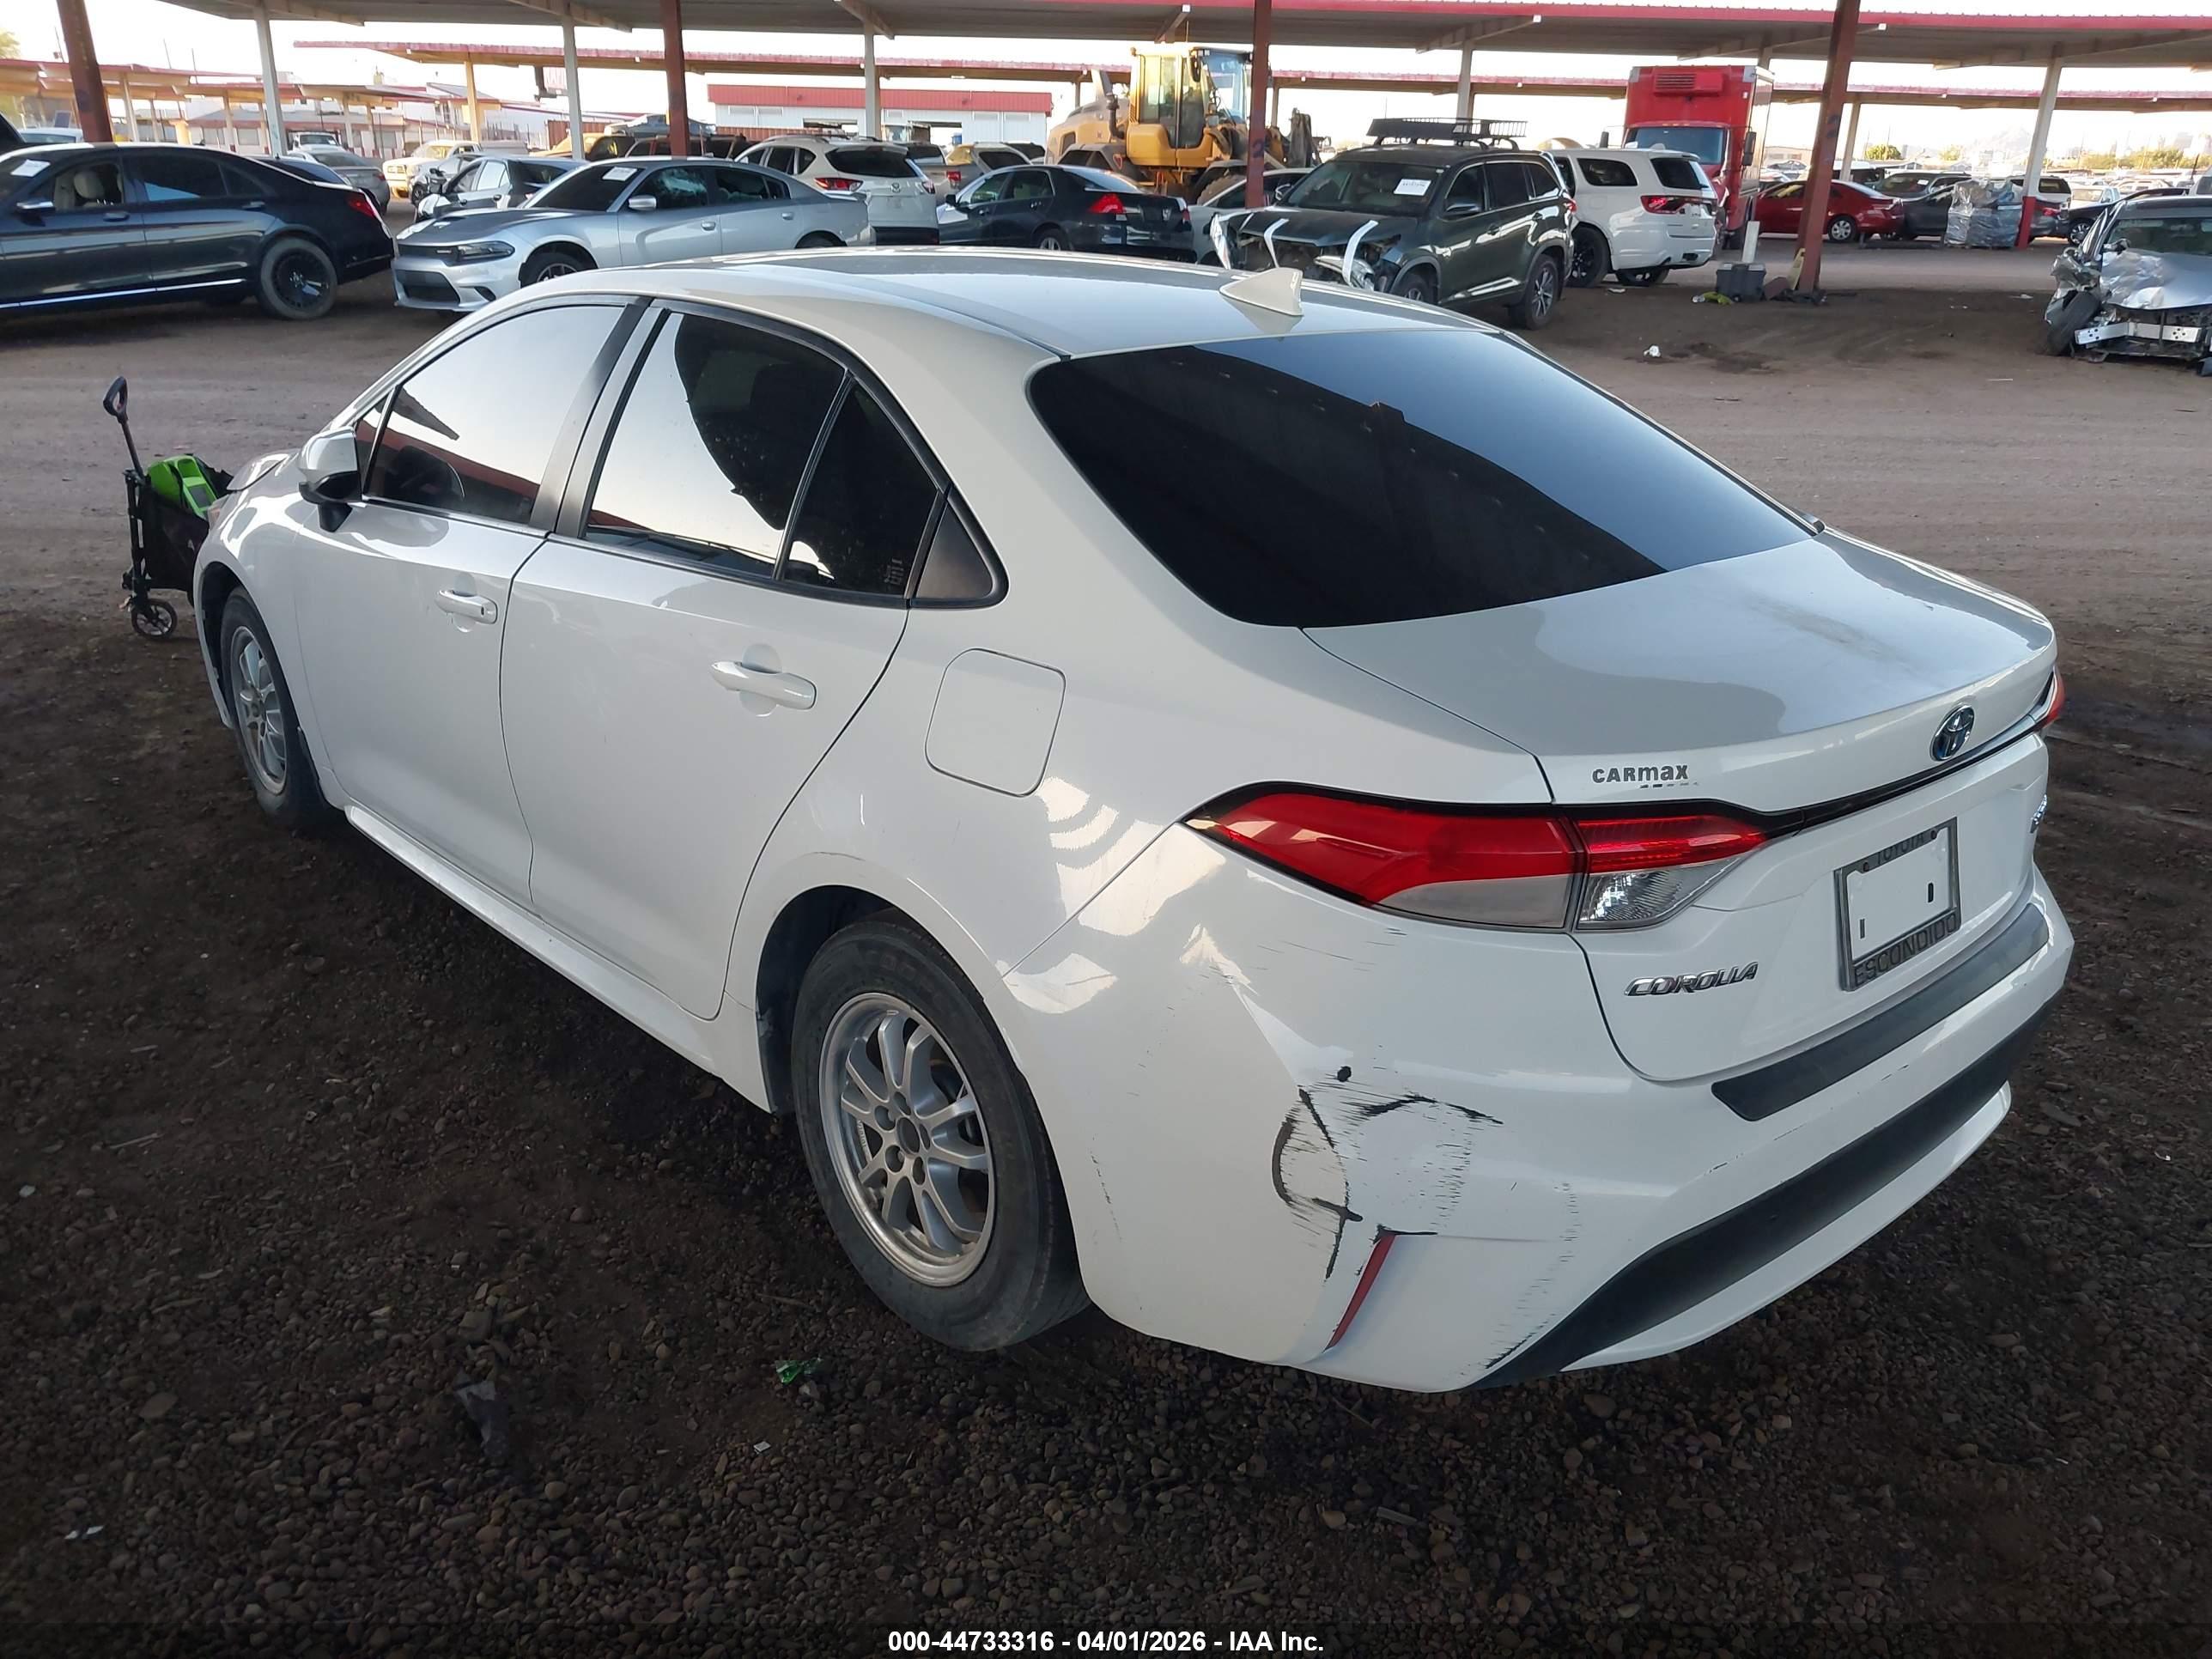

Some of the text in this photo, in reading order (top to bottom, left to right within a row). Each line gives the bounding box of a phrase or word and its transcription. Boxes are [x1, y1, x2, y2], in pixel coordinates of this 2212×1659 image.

[1876, 831, 1925, 866] TOYOTA
[1854, 912, 1957, 988] ESCONDIDO
[1624, 961, 1759, 996] COROLLA
